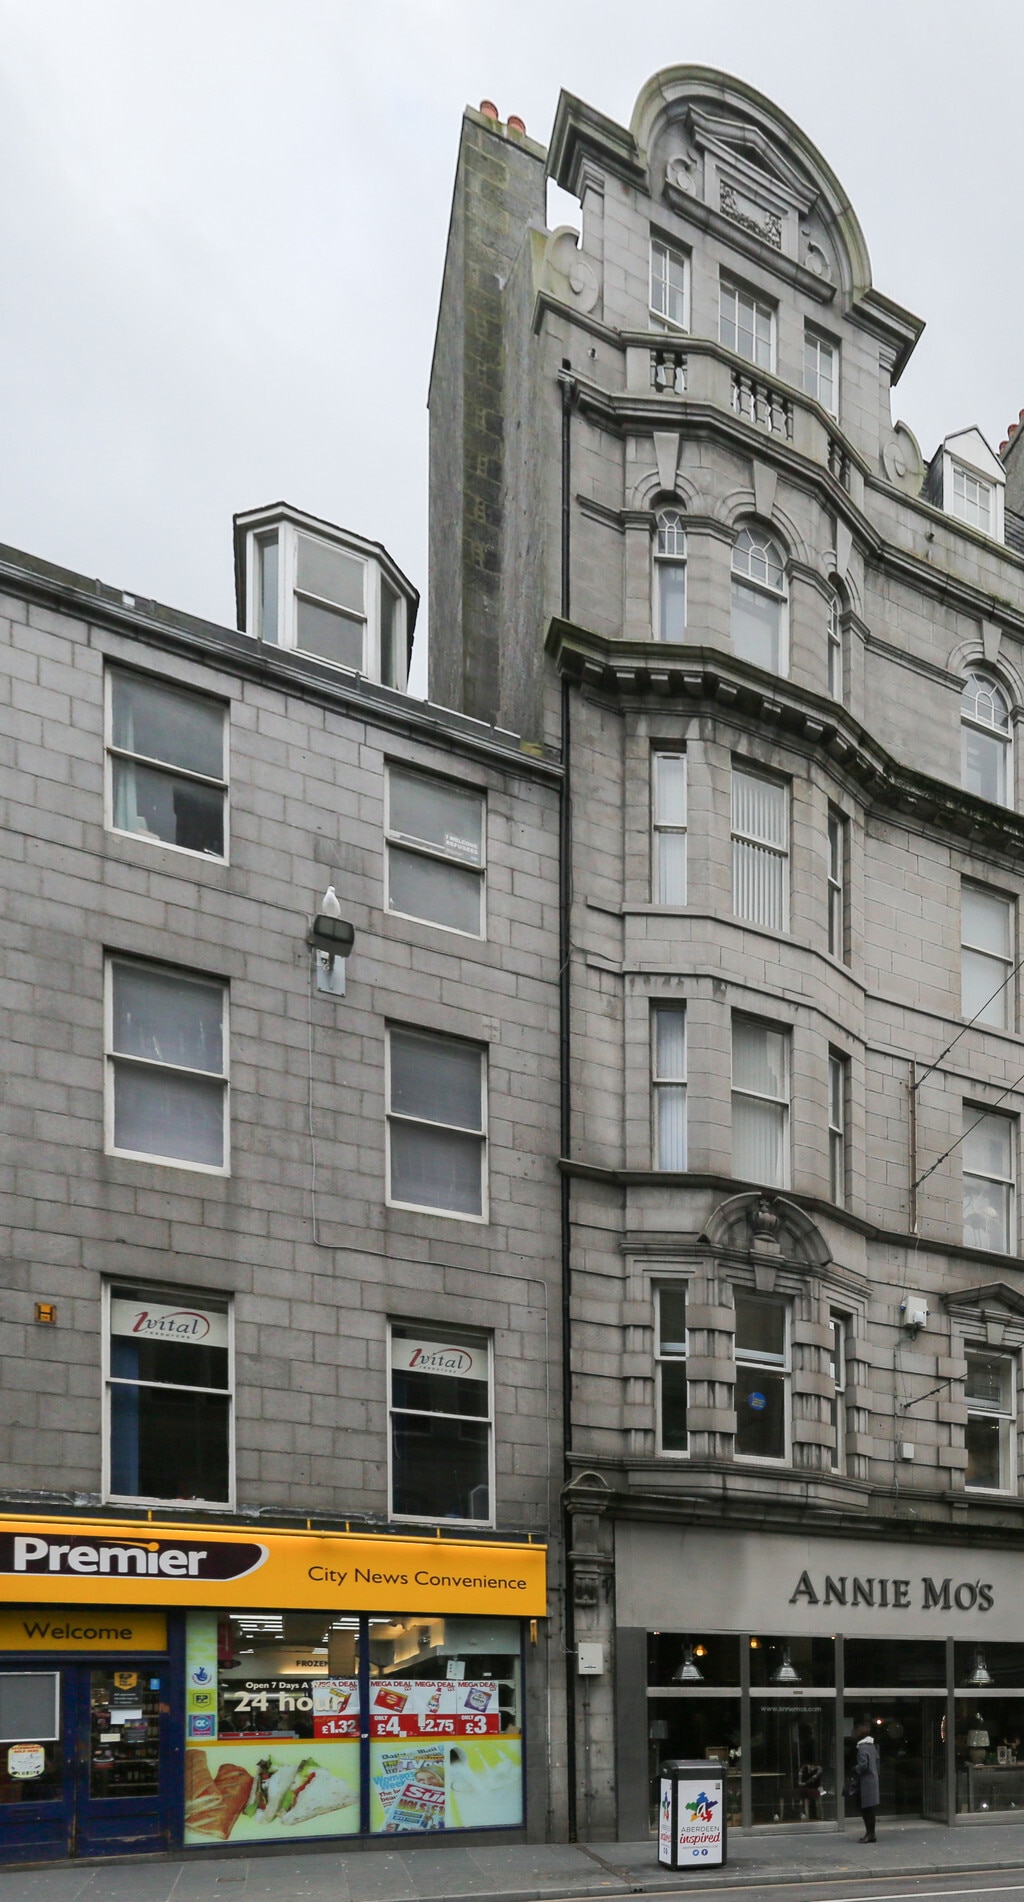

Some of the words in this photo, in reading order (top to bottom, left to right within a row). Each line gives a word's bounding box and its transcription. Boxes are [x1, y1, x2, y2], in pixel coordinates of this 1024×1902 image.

[13, 1536, 208, 1576] Premier
[308, 1566, 348, 1586] City
[354, 1569, 408, 1585] News
[415, 1571, 527, 1589] Convenience
[788, 1569, 912, 1608] ANNIE
[921, 1576, 995, 1612] MO'S
[23, 1621, 133, 1640] Welcome
[245, 1681, 269, 1689] Open
[279, 1681, 300, 1689] Days
[234, 1691, 269, 1711] 24
[322, 1720, 357, 1734] £1.32
[466, 1715, 487, 1734] £3
[680, 1832, 721, 1846] inspired
